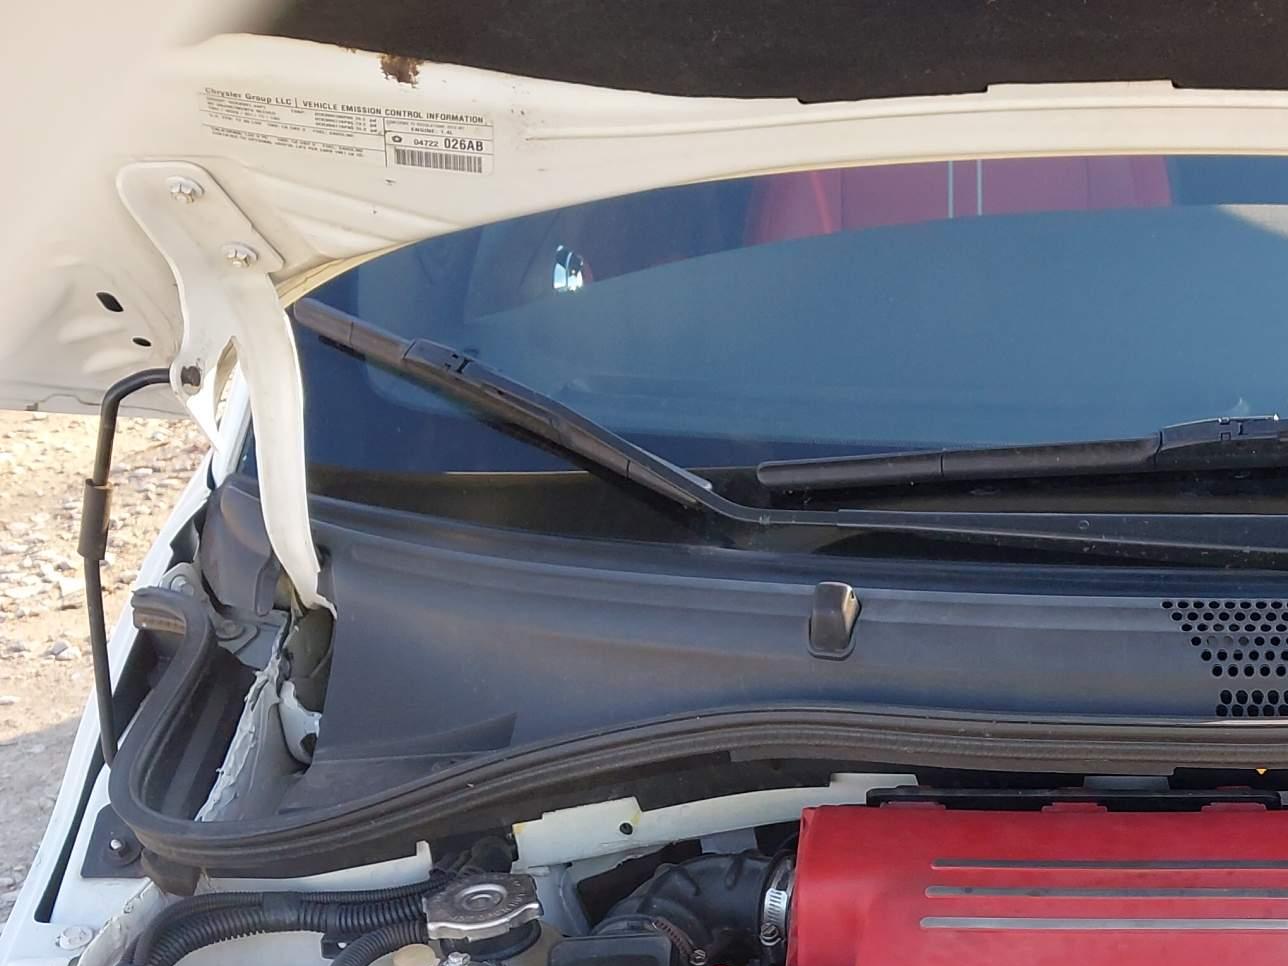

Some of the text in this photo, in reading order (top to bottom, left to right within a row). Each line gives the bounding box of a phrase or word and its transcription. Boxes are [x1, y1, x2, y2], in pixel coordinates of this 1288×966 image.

[205, 88, 292, 105] Chrysler Group LLC
[303, 100, 484, 123] VEHICLE EMISSION CONTROL INFORMATION
[444, 138, 484, 151] 026AB
